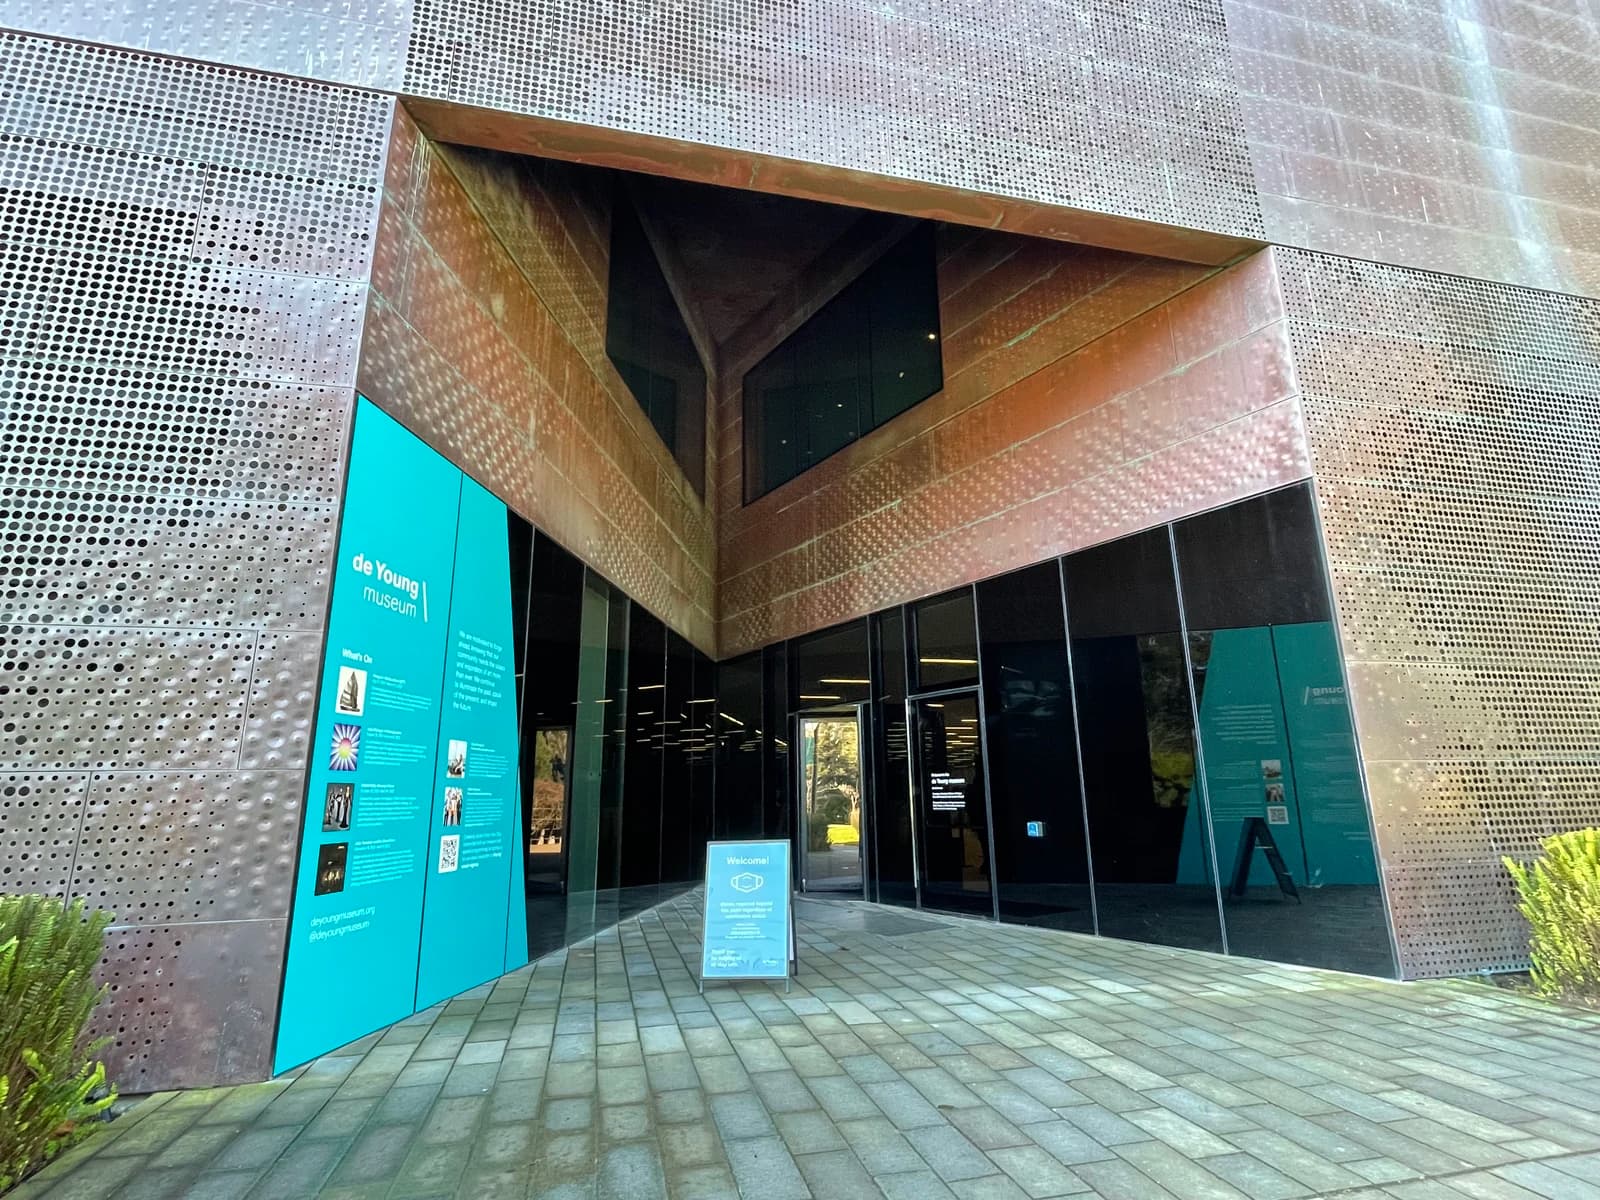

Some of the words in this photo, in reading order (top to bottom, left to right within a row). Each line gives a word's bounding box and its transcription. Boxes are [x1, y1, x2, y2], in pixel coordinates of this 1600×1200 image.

[352, 552, 373, 576] de
[375, 559, 419, 600] Young
[363, 586, 417, 618] museum
[363, 654, 373, 664] On
[726, 856, 770, 865] Welcome!
[310, 906, 376, 928] deyoungmuseum.org
[309, 920, 370, 944] @deyoungmuseum
